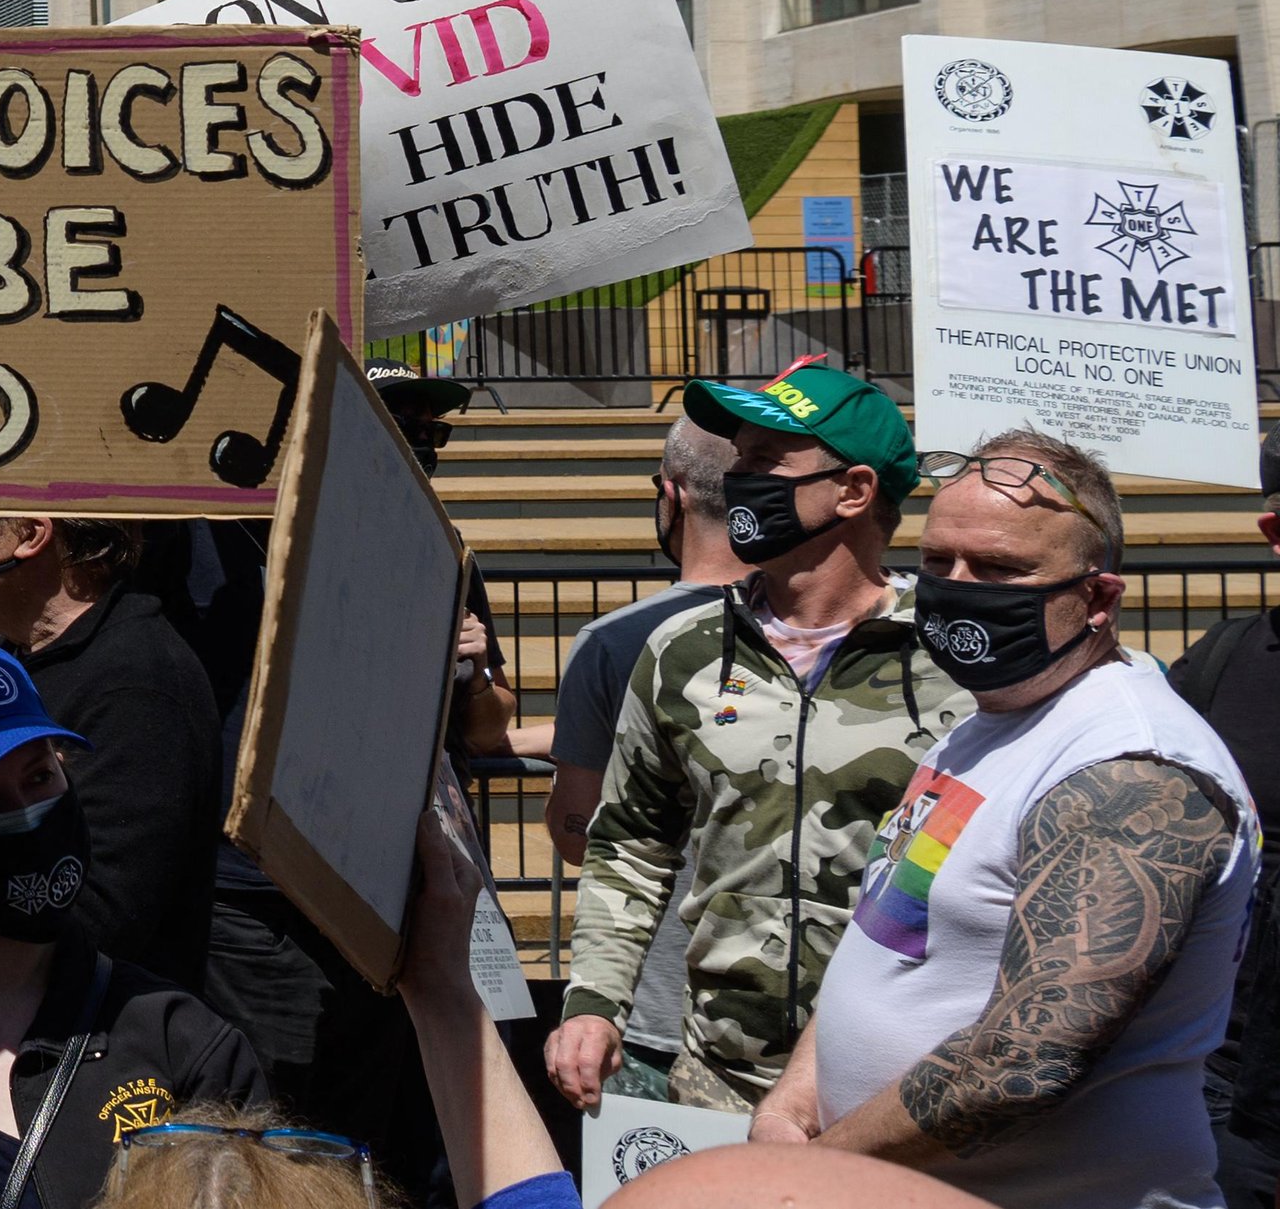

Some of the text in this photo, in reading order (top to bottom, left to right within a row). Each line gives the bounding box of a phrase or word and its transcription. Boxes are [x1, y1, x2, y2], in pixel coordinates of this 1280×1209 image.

[389, 71, 623, 186] HIDE
[942, 164, 1014, 204] WE
[380, 137, 686, 270] TRUTH!
[972, 213, 1058, 258] ARE
[1128, 219, 1153, 234] ONE
[1021, 268, 1226, 328] THE MET
[936, 327, 1241, 375] THEATRICAL PROTECTIVE UNION
[1015, 356, 1163, 387] LOCAL NO. ONE
[949, 374, 1018, 387] INTERNATIONAL
[1023, 381, 1066, 392] ALLIANCE
[1088, 388, 1140, 400] THEATRICAL
[1145, 394, 1173, 403] STAGE
[949, 383, 984, 392] MOVING
[988, 386, 1026, 396] PICTURE
[1138, 403, 1157, 411] AND
[1161, 405, 1191, 414] ALLIED
[1195, 409, 1232, 419] CRAFTS
[950, 391, 967, 399] THE
[970, 393, 1002, 403] UNITED
[1043, 400, 1057, 409] ITS
[1126, 410, 1144, 418] AND
[1232, 422, 1250, 431] CLC
[1035, 408, 1051, 417] 320
[1055, 410, 1080, 420] WEST
[1111, 417, 1146, 427] STREET
[1043, 418, 1064, 427] NEW
[1098, 425, 1111, 433] NY
[1116, 426, 1140, 436] 10036
[950, 634, 982, 656] 829
[957, 630, 982, 640] USA
[99, 1091, 132, 1120] OFFICER
